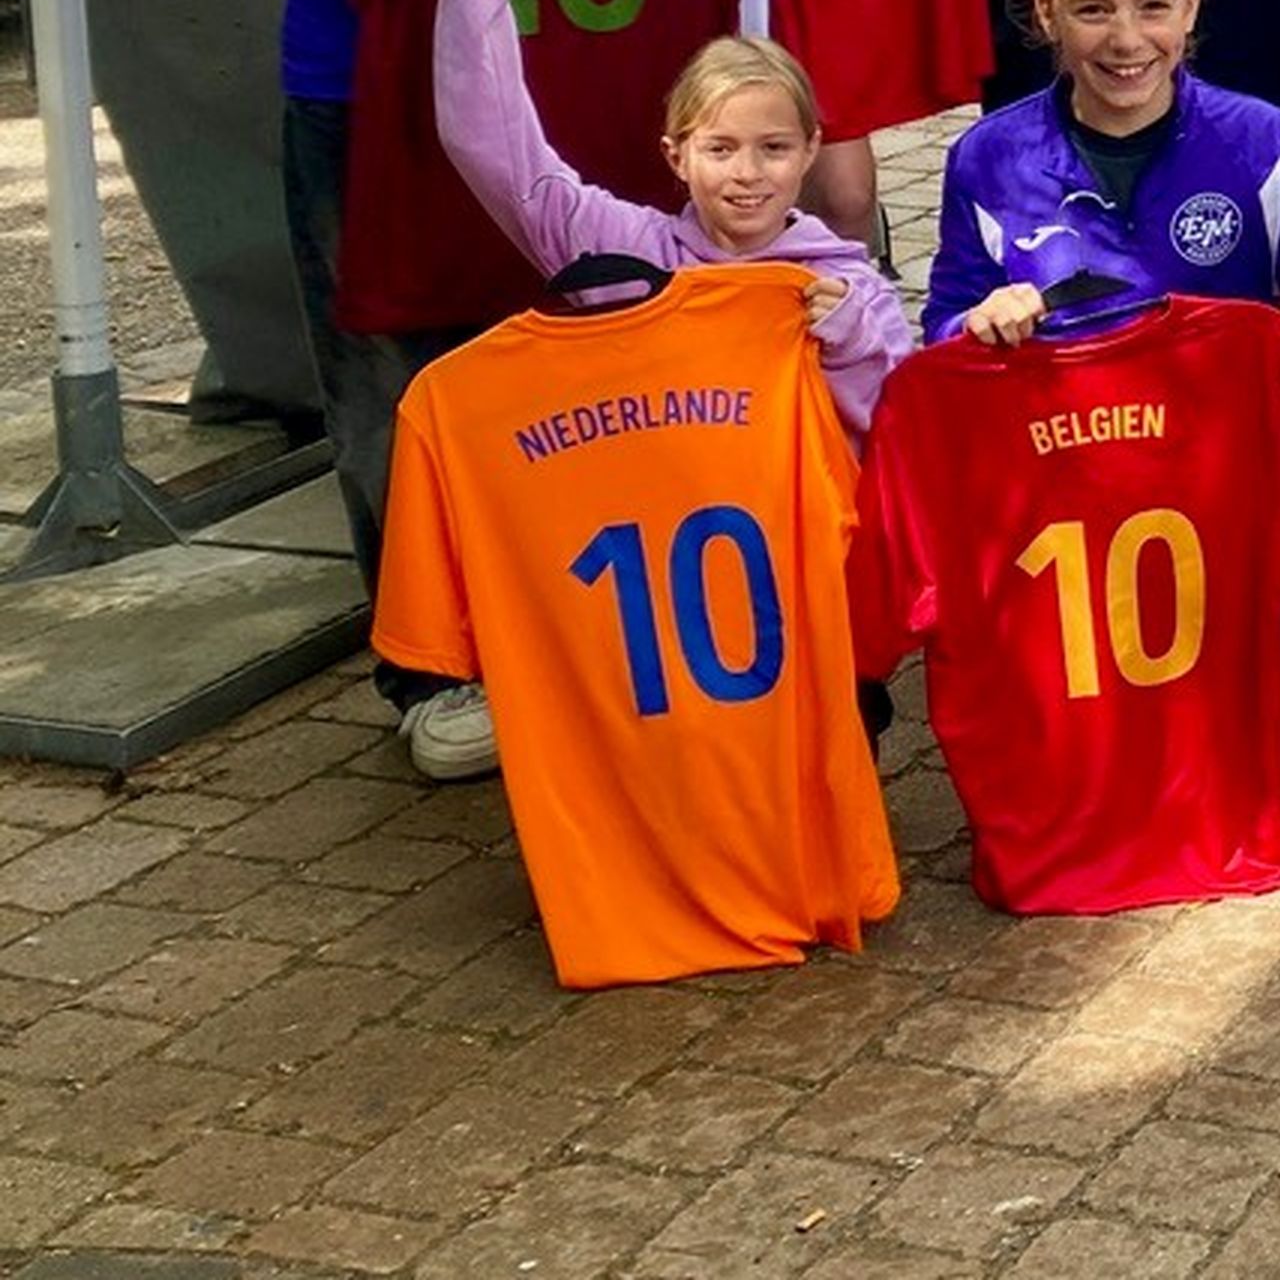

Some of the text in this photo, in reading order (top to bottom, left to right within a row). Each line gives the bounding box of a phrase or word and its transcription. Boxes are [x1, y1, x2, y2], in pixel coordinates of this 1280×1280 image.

[515, 389, 752, 462] NIEDERLANDE
[1029, 403, 1166, 456] BELGIEN
[568, 505, 785, 717] 10
[1015, 508, 1205, 699] 10
